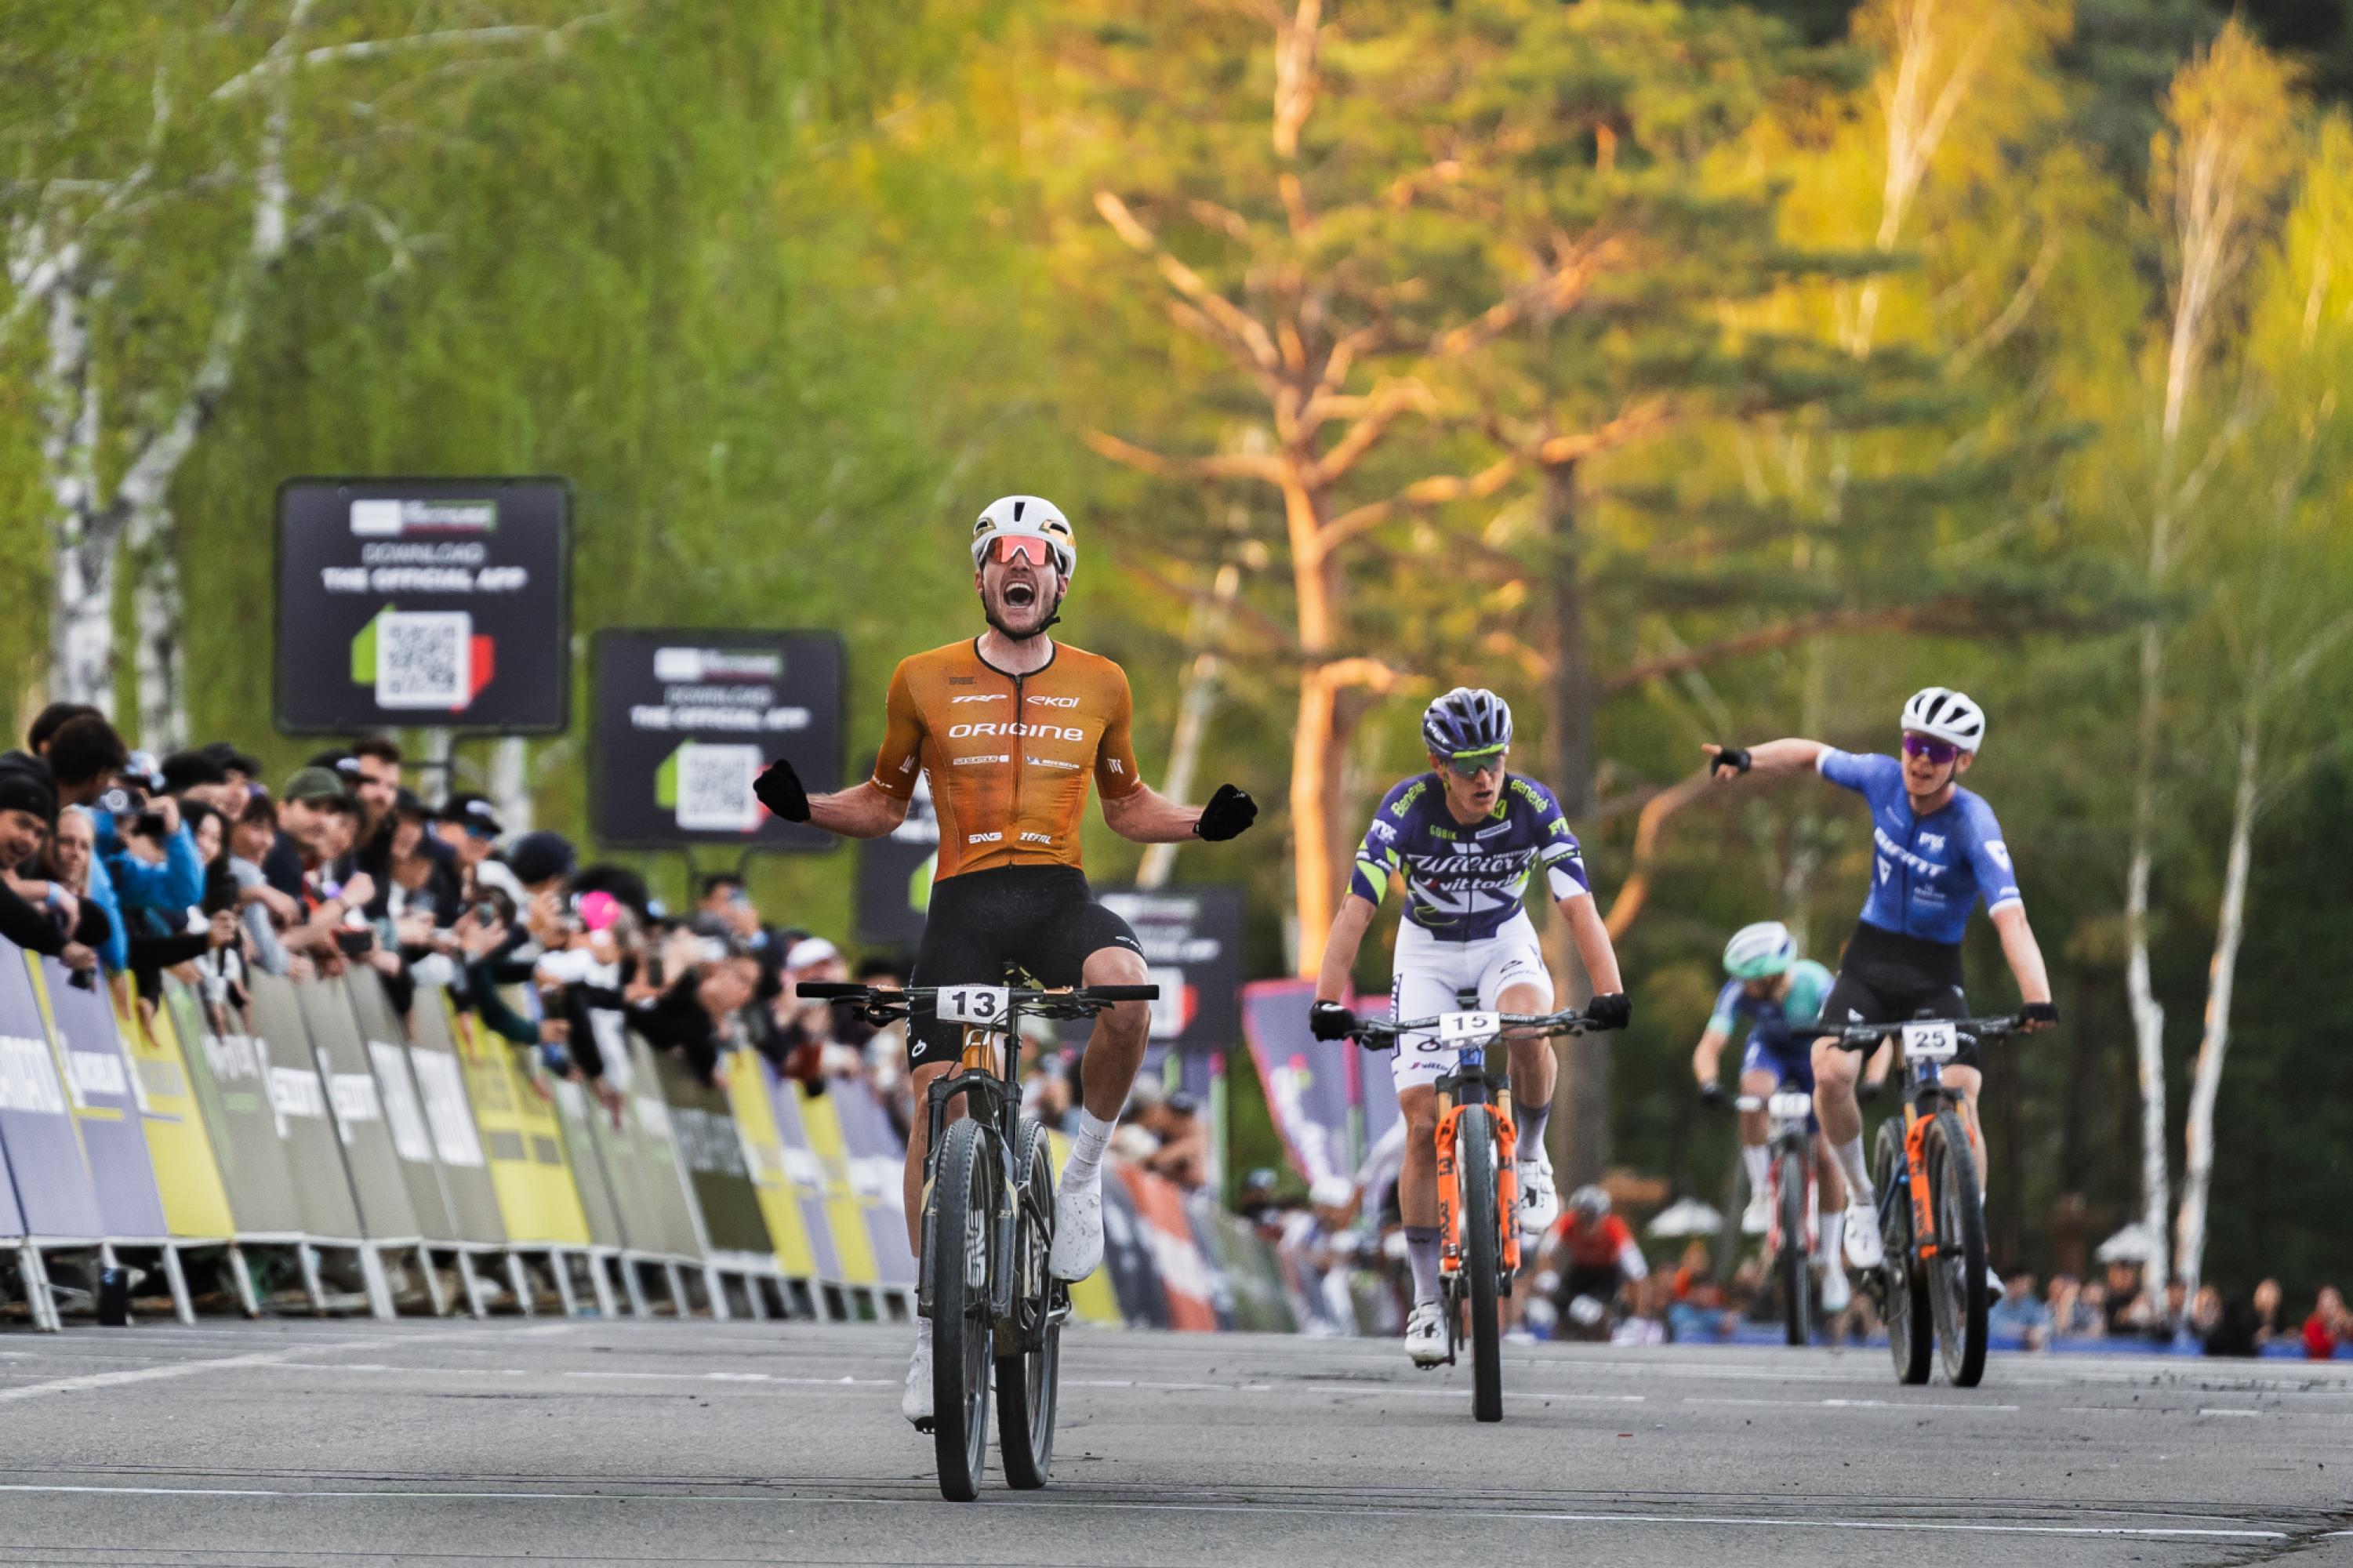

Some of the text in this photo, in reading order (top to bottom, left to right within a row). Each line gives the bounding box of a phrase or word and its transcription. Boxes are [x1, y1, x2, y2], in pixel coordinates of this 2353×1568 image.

[361, 542, 486, 565] DOWNLOAD
[321, 565, 528, 592] THE OFFICIAL APP
[664, 684, 773, 706] DOWNLOAD
[951, 693, 1008, 704] TRP
[630, 705, 810, 731] THE OFFICIAL APP
[1429, 824, 1458, 840] GOBIK
[1407, 849, 1535, 873] Wilier
[951, 991, 996, 1018] 13
[1452, 1015, 1489, 1032] 15
[1915, 1031, 1946, 1047] 25
